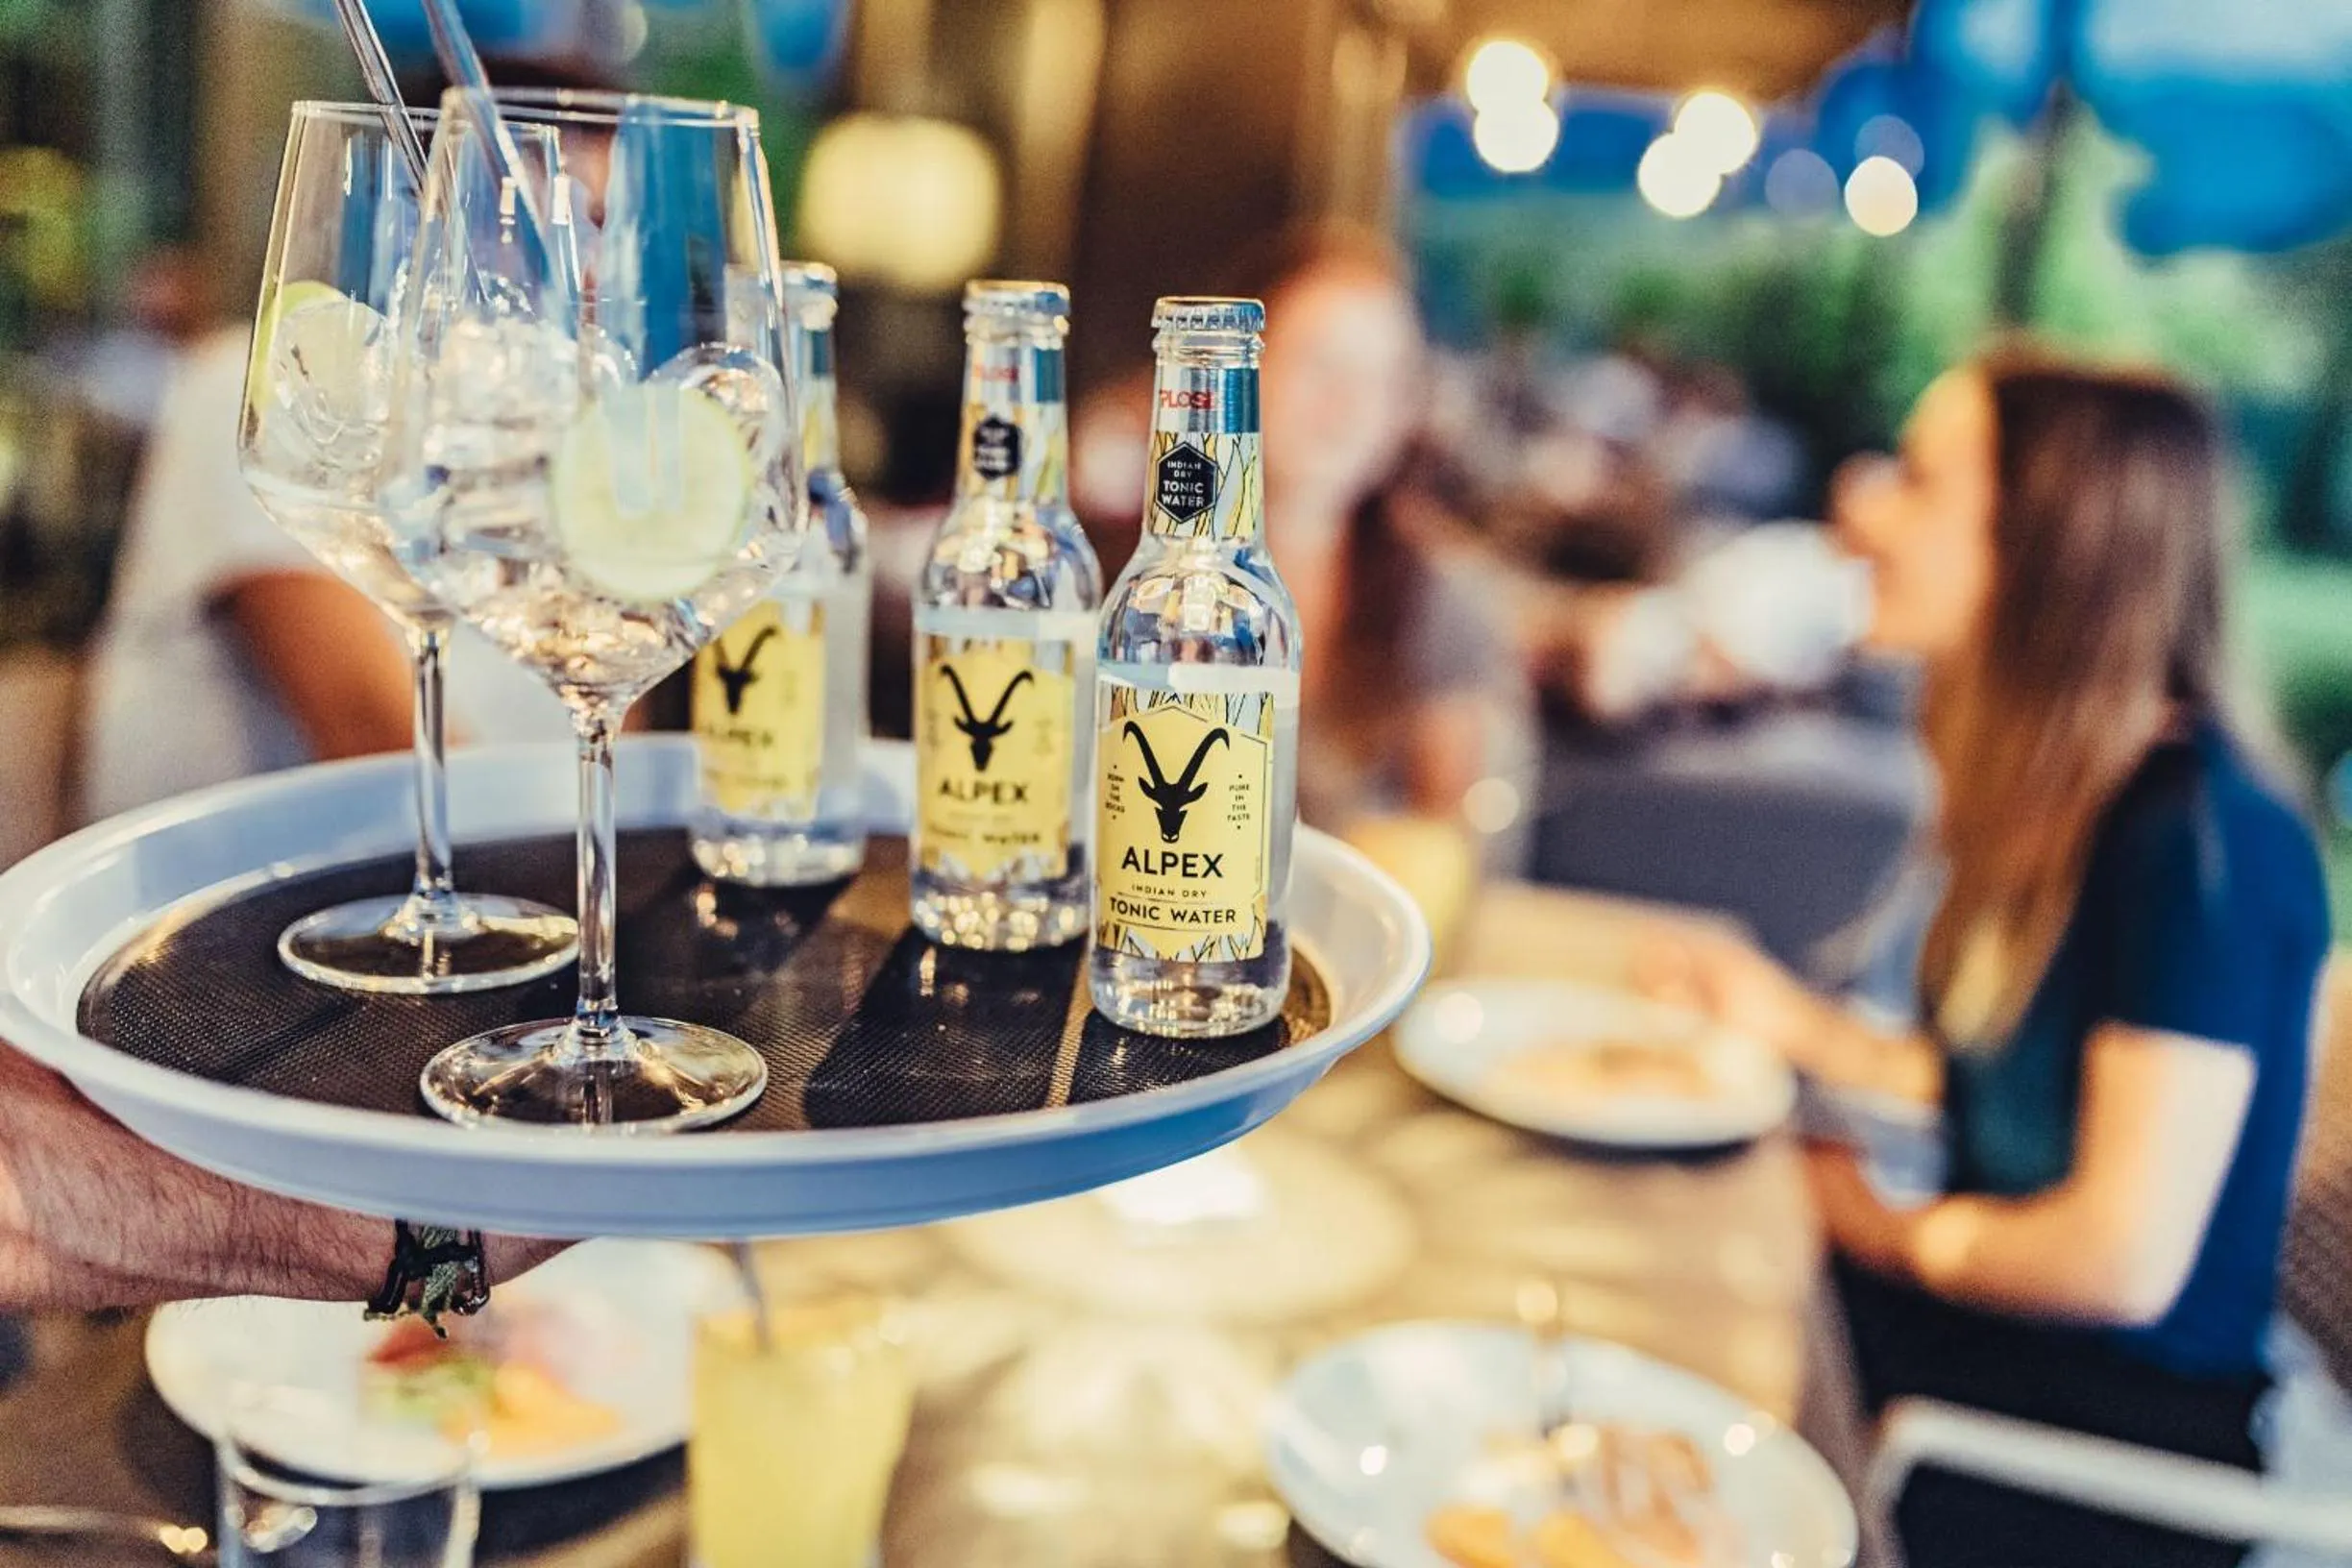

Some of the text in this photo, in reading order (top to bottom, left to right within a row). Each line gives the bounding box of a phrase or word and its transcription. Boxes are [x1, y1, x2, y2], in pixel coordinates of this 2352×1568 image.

[1166, 460, 1202, 470] INDIAN
[1173, 470, 1192, 478] DRY
[1163, 479, 1205, 494] TONIC
[1161, 493, 1204, 508] WATER
[938, 777, 1030, 805] ALPEX
[1121, 845, 1224, 878] ALPEX
[1132, 884, 1175, 896] INDIAN
[1110, 895, 1236, 923] TONIC WATER
